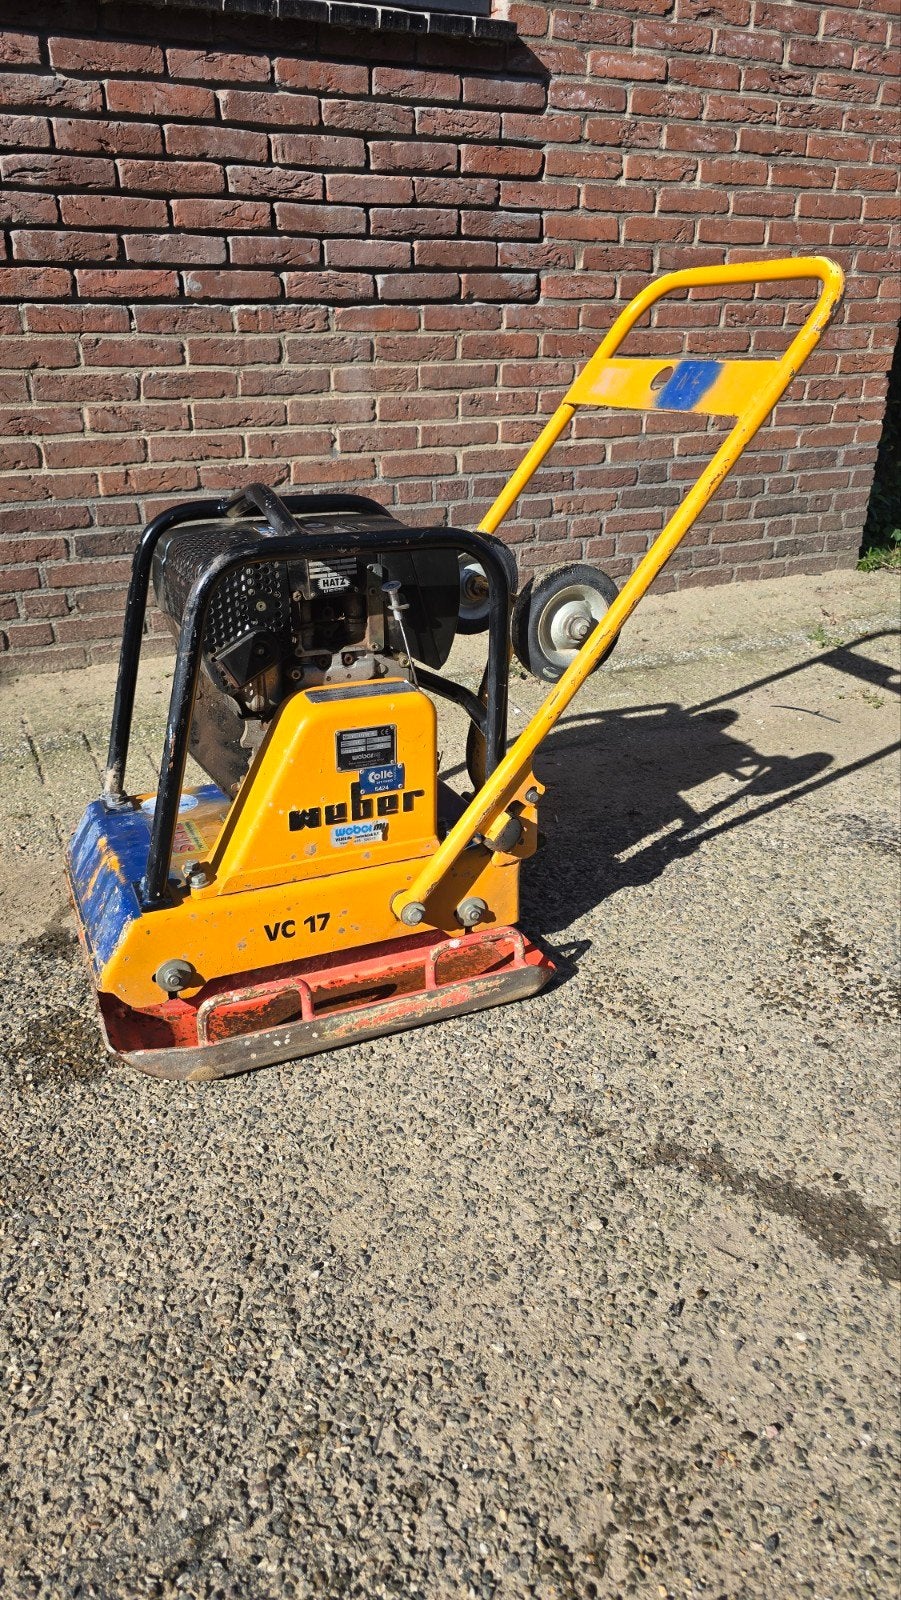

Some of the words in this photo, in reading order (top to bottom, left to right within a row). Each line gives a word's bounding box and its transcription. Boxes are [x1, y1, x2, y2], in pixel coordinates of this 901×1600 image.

[322, 578, 346, 587] HATZ
[289, 782, 425, 832] weber
[264, 919, 296, 942] VC
[304, 912, 331, 934] 17
